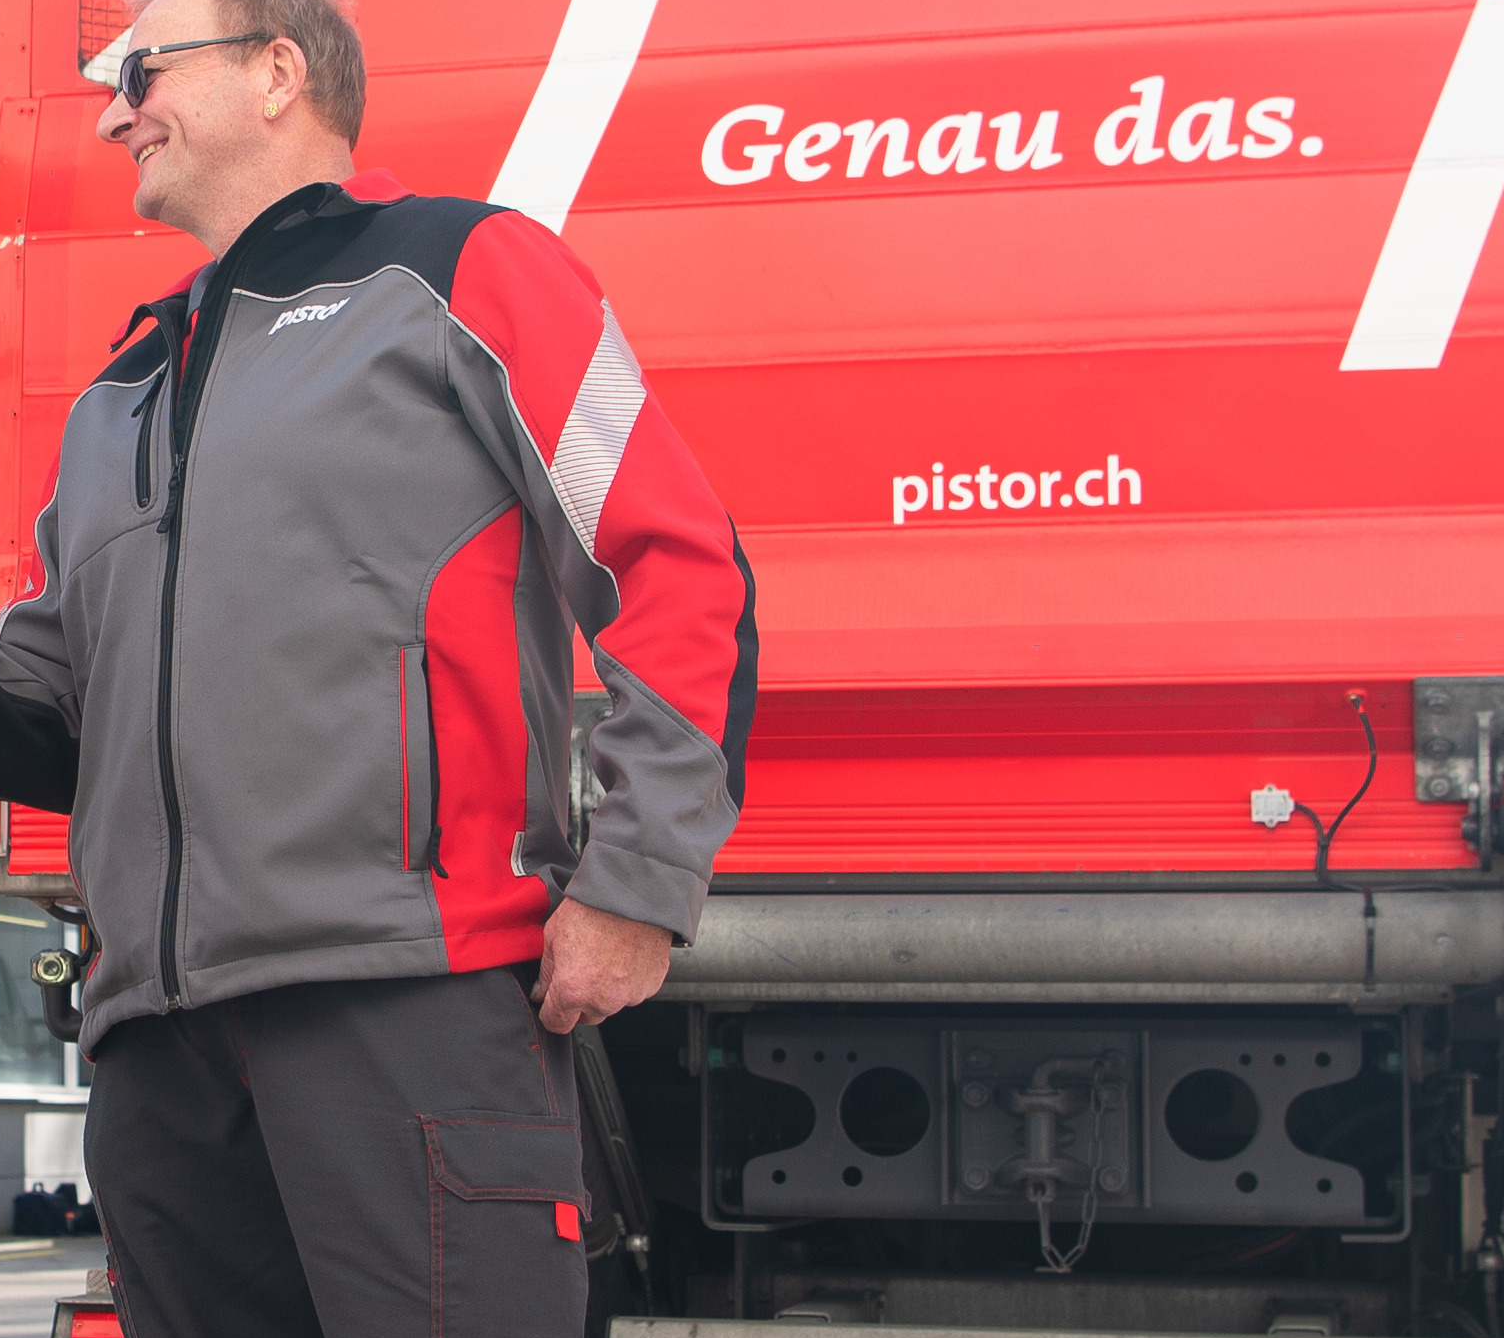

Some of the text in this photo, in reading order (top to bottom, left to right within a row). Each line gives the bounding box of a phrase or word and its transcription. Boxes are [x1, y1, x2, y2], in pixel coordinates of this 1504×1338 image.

[701, 75, 1324, 186] Genau das.
[893, 455, 1142, 525] pistor.ch
